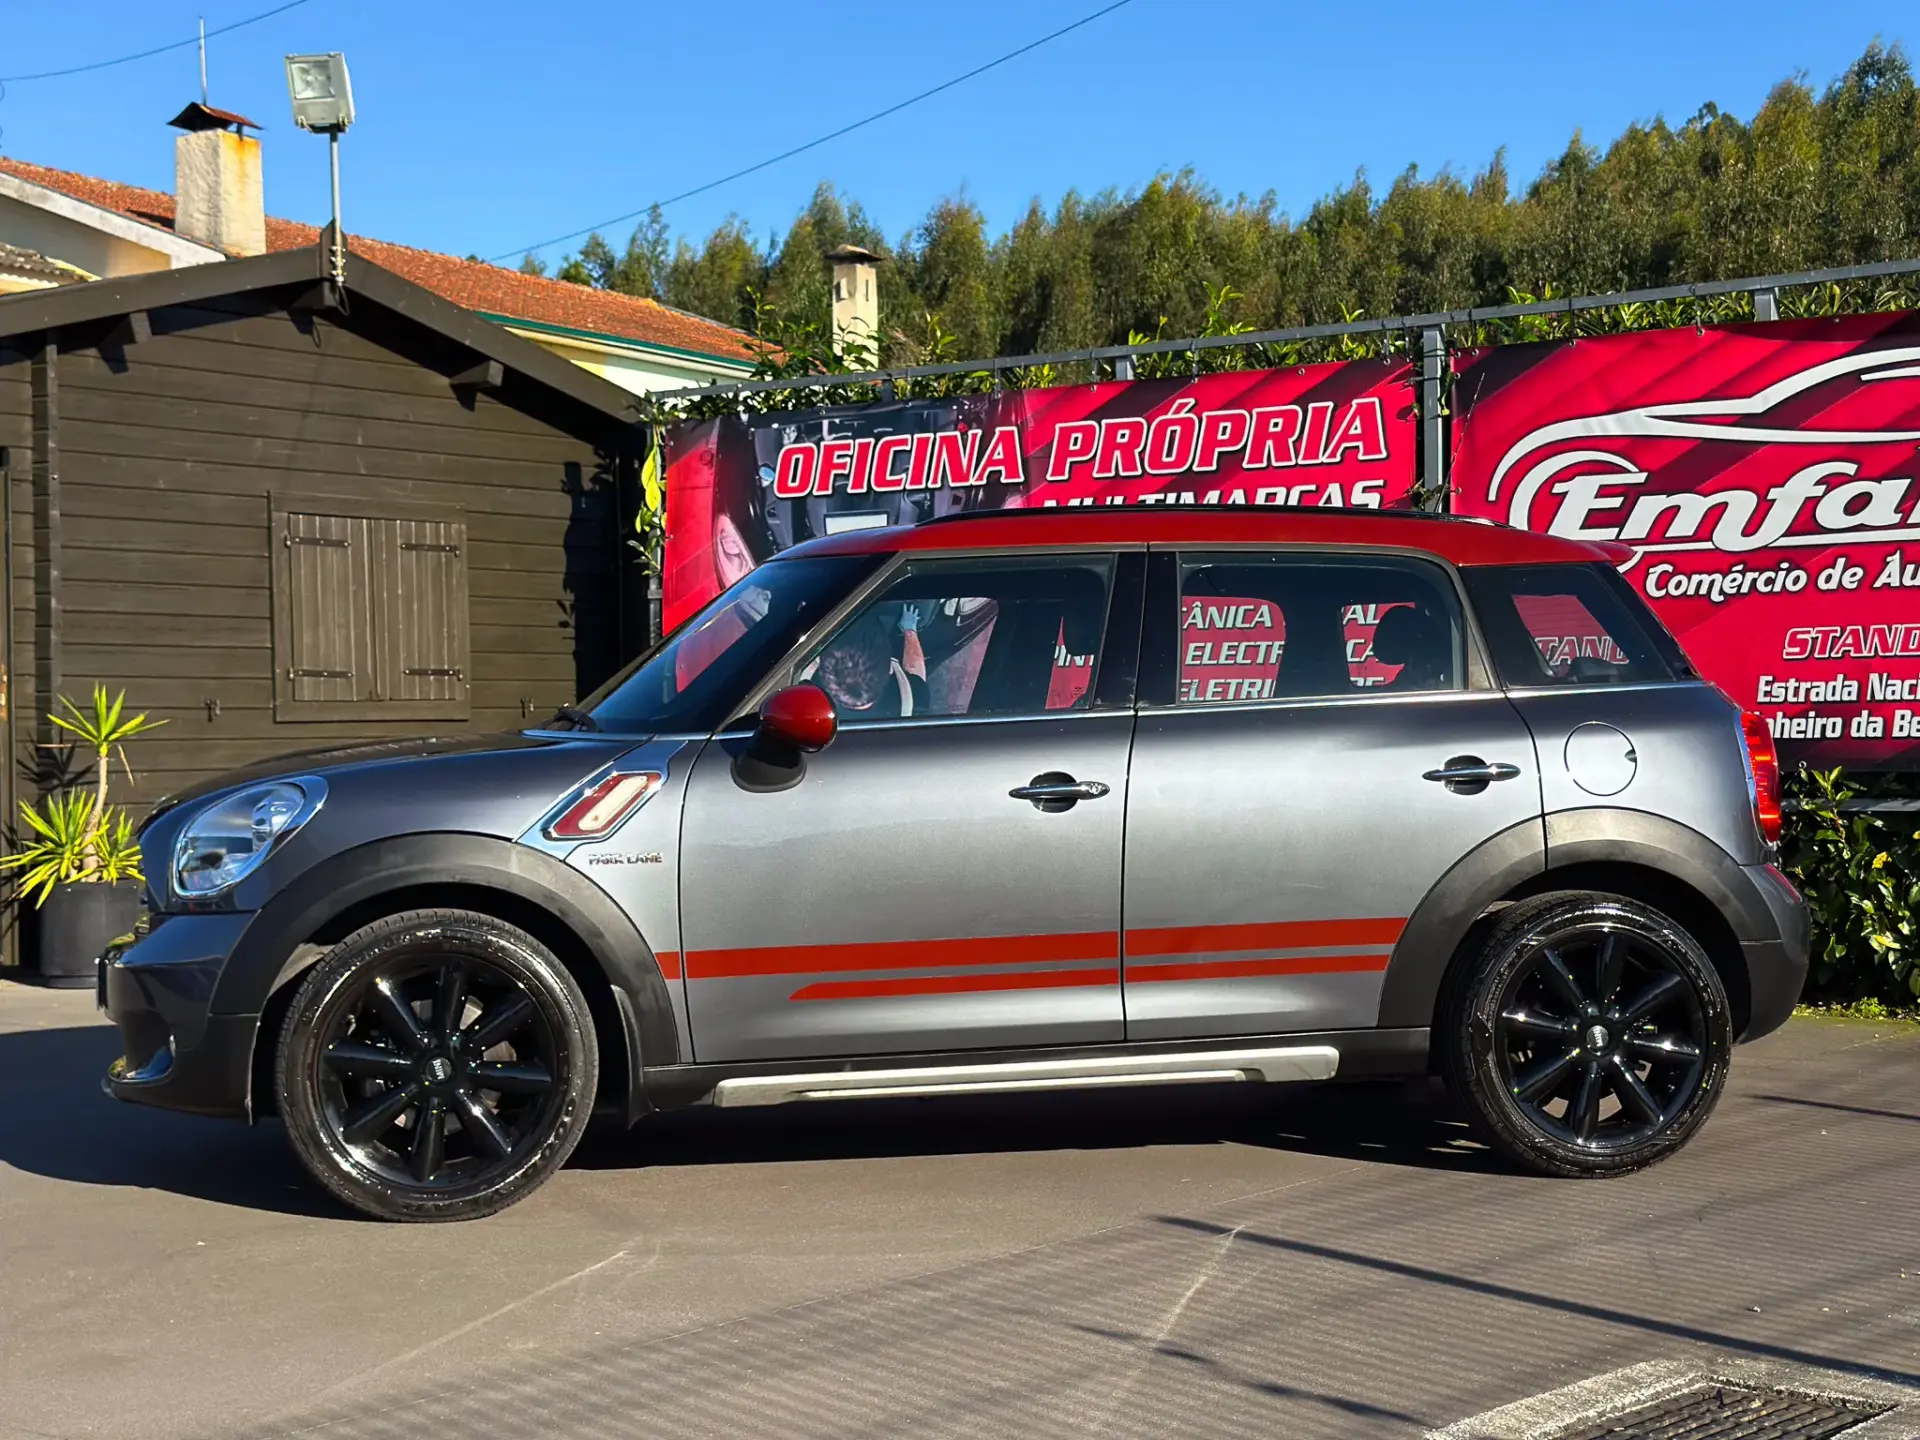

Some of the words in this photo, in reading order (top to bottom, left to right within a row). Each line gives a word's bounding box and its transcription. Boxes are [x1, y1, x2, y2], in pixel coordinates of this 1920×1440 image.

[773, 426, 1025, 498] OFICINA
[1046, 397, 1387, 480] PRÓPRIA
[1547, 461, 1920, 552] Emfa
[1646, 562, 1808, 602] Comércio
[1817, 557, 1864, 590] de
[1182, 601, 1272, 629] ÂNICA
[1180, 679, 1276, 701] ELETRI
[1757, 673, 1860, 702] Estrada
[1753, 711, 1842, 739] heiro
[1850, 709, 1884, 738] da
